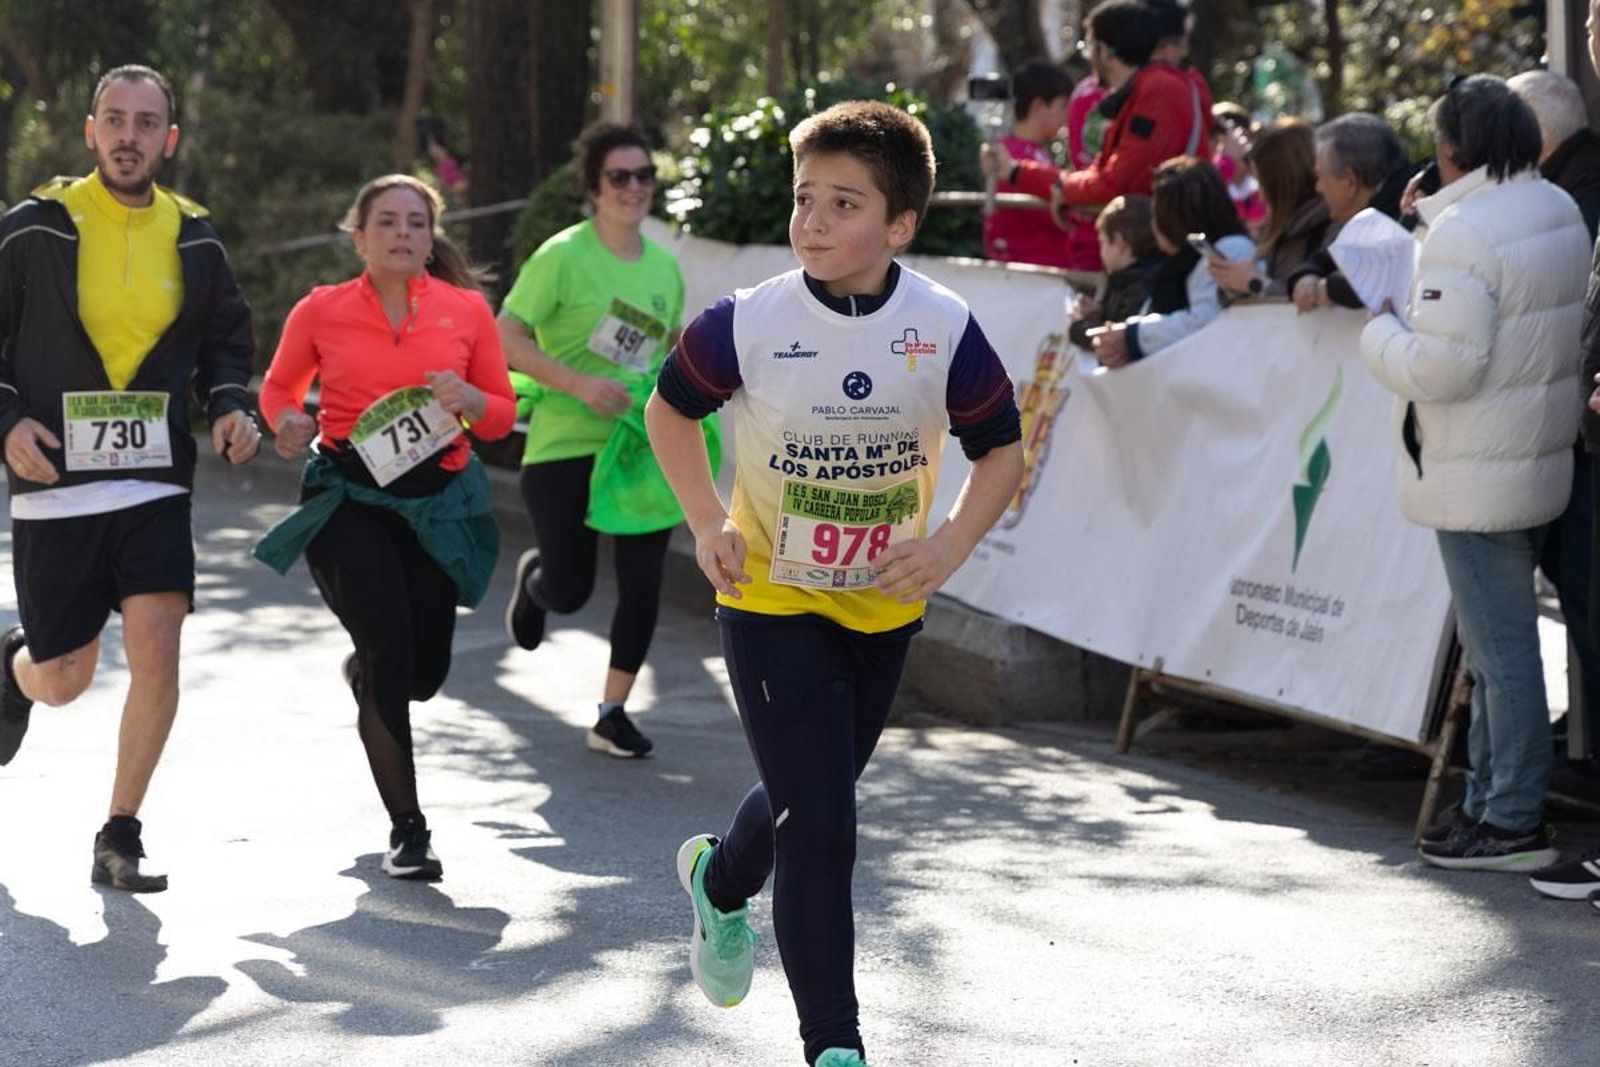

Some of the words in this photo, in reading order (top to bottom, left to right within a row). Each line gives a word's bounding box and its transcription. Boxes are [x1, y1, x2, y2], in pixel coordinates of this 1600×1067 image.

[773, 351, 818, 359] TEAMERGY
[811, 405, 846, 415] PABLO
[849, 405, 901, 415] CARVAJAL
[91, 419, 146, 451] 730
[381, 409, 431, 455] 731
[783, 431, 823, 446] CLUB
[830, 434, 850, 446] DE
[785, 443, 858, 461] SANTA
[866, 443, 891, 460] Mª
[897, 440, 919, 456] DE
[769, 454, 808, 478] LOS
[811, 488, 830, 503] SAN
[833, 492, 860, 506] JUAN
[793, 499, 801, 511] IV
[804, 500, 841, 520] CARRERA
[844, 507, 881, 521] POPULAR
[811, 522, 892, 567] 978
[1236, 603, 1286, 634] Deportes
